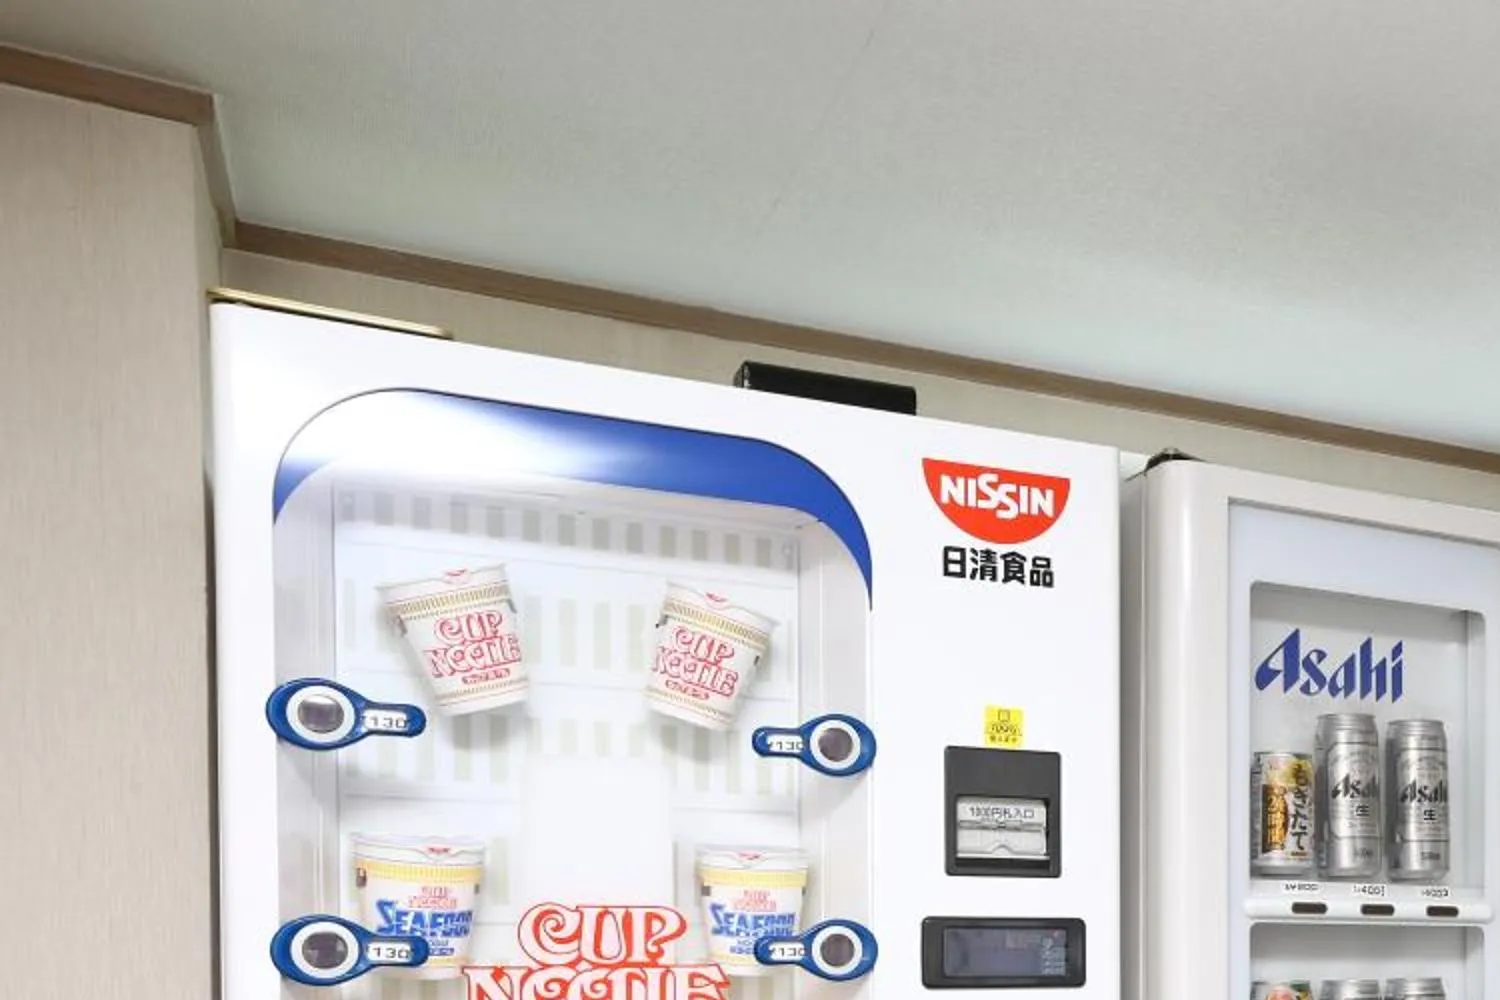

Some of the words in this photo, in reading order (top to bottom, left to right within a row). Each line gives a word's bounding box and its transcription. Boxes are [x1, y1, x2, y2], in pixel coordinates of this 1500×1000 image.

[940, 471, 1054, 519] NISSIN
[942, 546, 1055, 588] 日清食品
[434, 610, 503, 644] CUP
[673, 625, 735, 665] CUP
[1255, 628, 1403, 703] Asahi
[1424, 809, 1438, 820] 生
[518, 903, 688, 968] CUP
